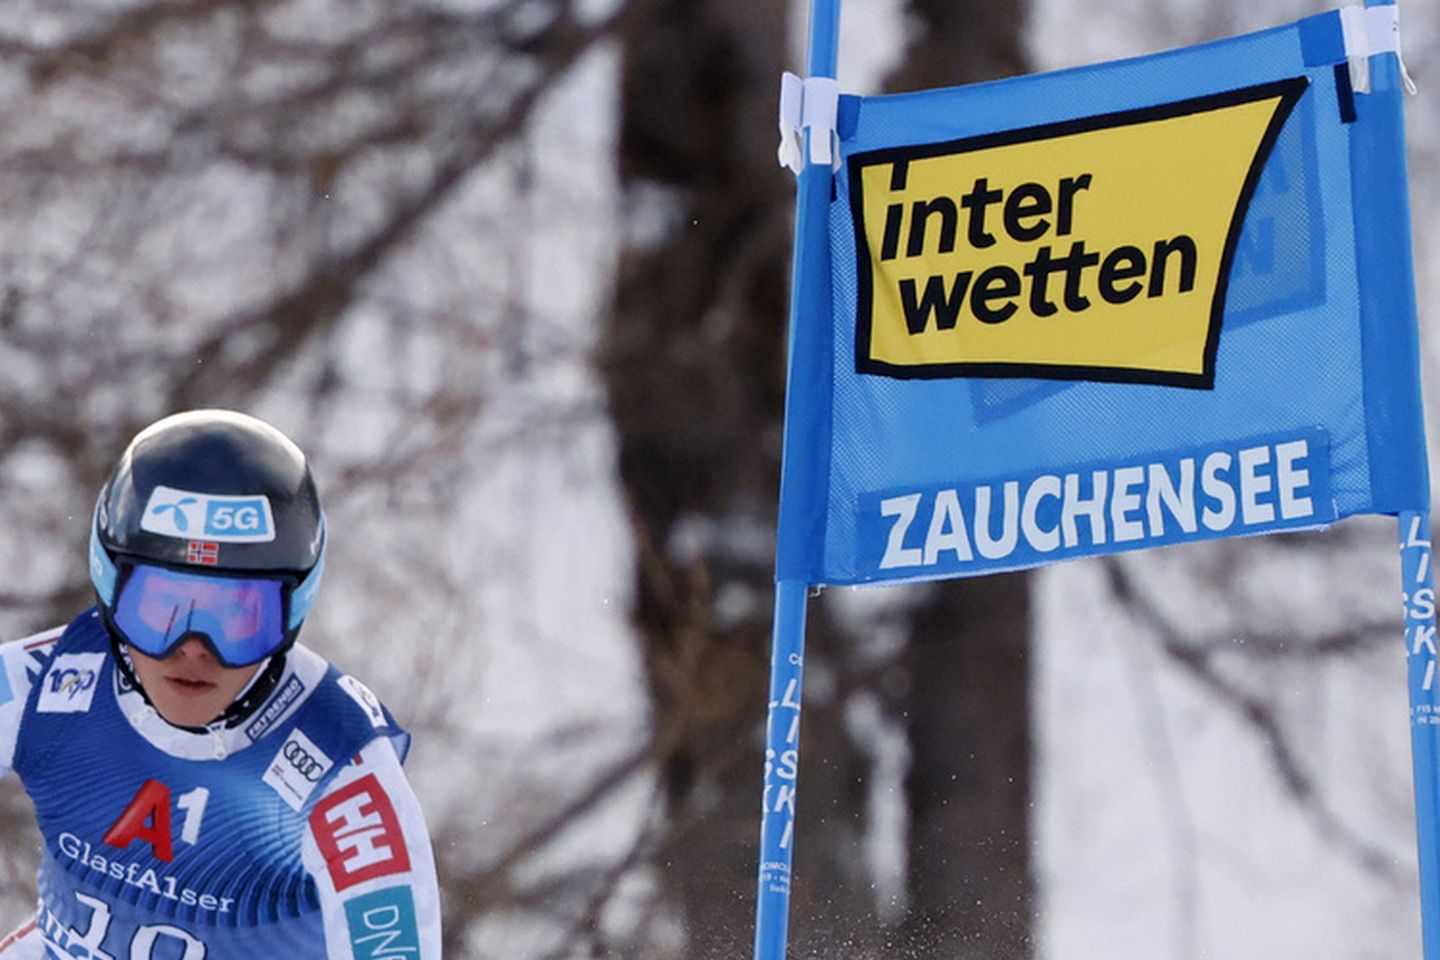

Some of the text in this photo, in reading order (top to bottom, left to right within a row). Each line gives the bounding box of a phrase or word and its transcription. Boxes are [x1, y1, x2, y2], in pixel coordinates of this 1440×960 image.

[881, 163, 1093, 261] inter
[898, 234, 1197, 335] wetten
[210, 506, 260, 531] 5G
[879, 439, 1314, 570] ZAUCHENSEE
[102, 778, 209, 863] A1
[324, 791, 395, 875] HH
